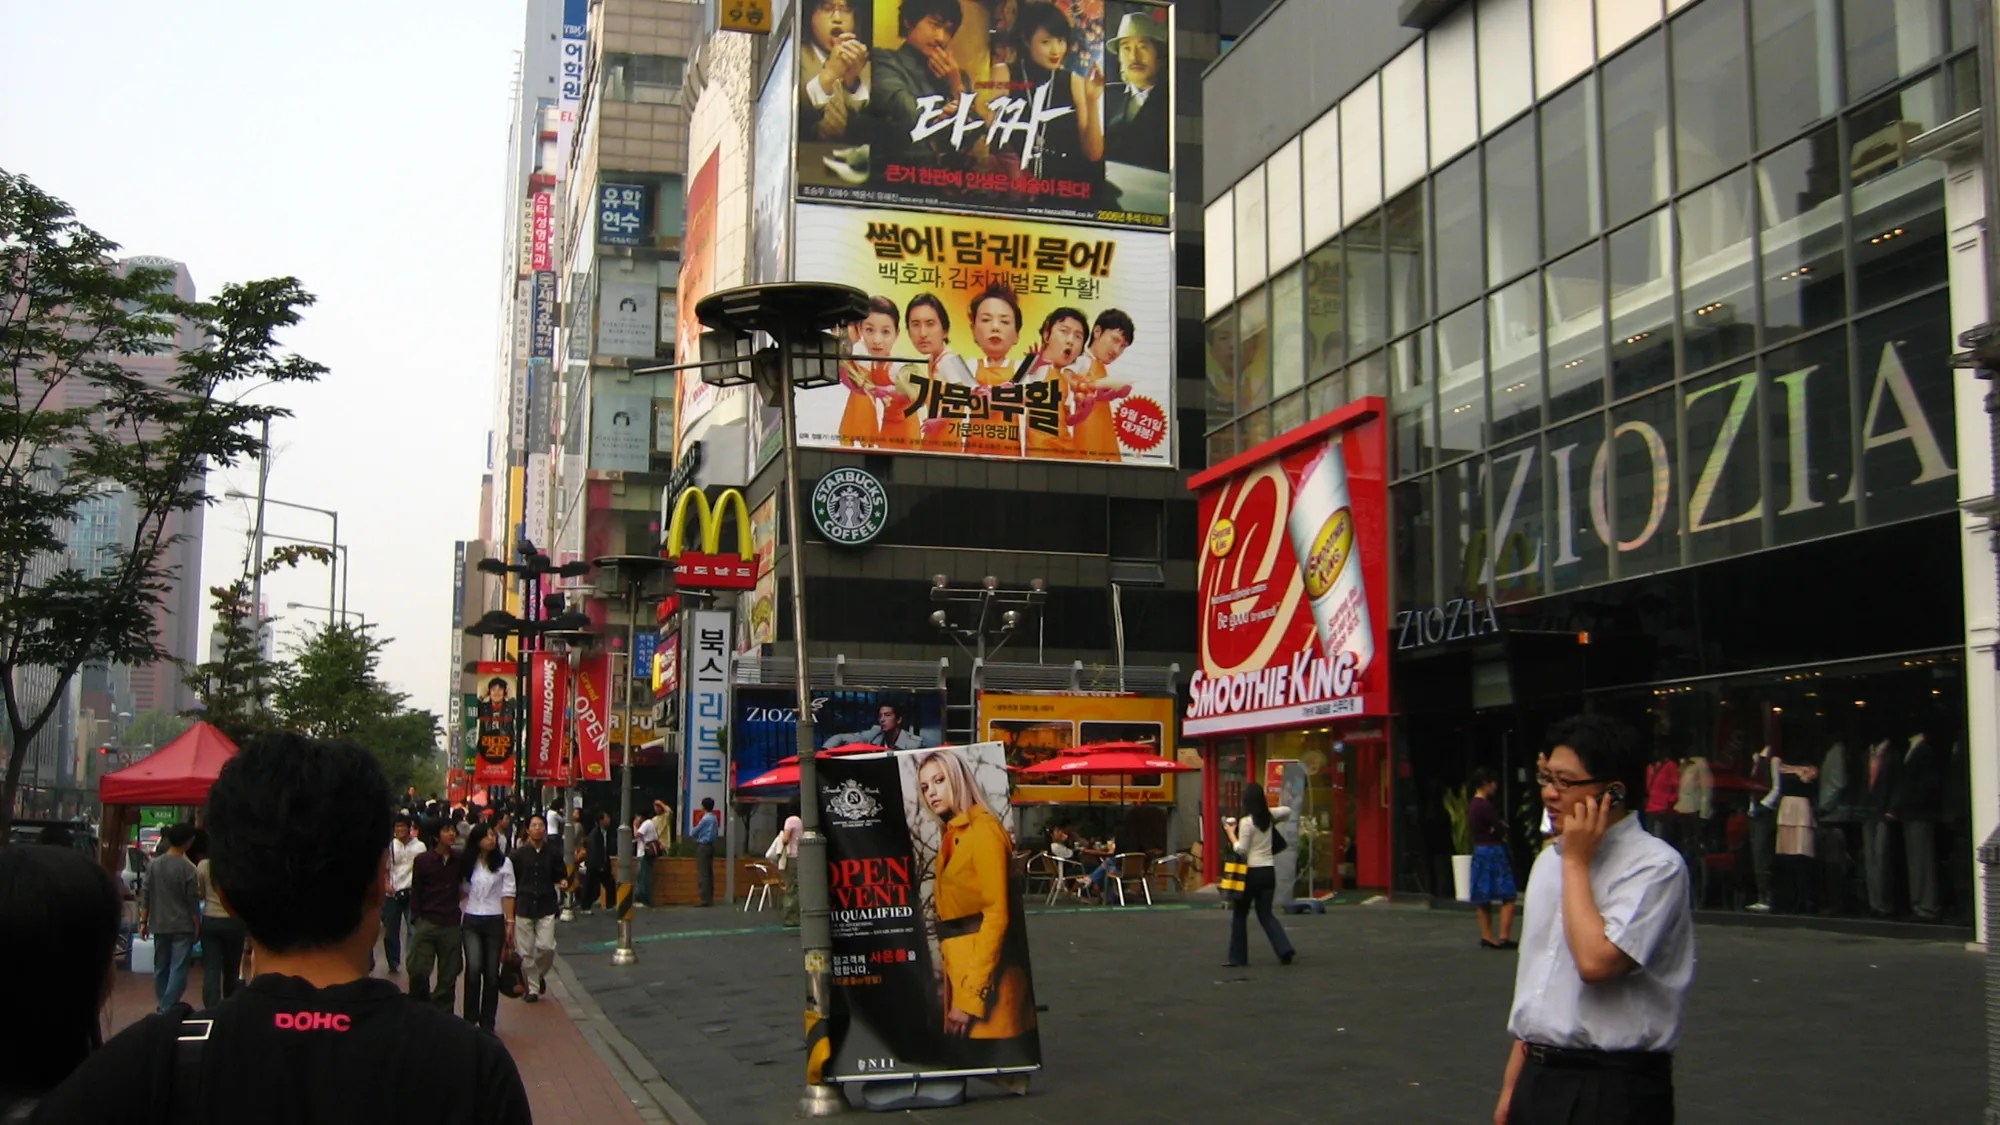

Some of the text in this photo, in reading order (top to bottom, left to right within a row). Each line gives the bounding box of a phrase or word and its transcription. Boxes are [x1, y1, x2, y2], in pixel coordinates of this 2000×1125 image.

[563, 43, 583, 100] 어학원
[909, 79, 1077, 171] 타짜
[885, 163, 916, 184] 큰거
[919, 168, 962, 188] 한판에
[966, 172, 1010, 193] 인생은
[602, 187, 641, 211] 유학
[602, 210, 640, 234] 연수
[866, 222, 945, 263] 썰어!
[1034, 236, 1116, 278] 묻어!
[878, 261, 1101, 300] 백호파, 김치재벌로 부활!
[904, 374, 1063, 437] 가문의 부활
[1120, 406, 1164, 430] 9월 21일
[1121, 420, 1154, 442] 대개봉!
[1478, 341, 1959, 588] ZIOZIA
[816, 471, 883, 506] STARBUCKS
[823, 520, 877, 540] COFFEE
[1397, 597, 1500, 650] ZIOZIA
[542, 659, 557, 726] SMOOTHIE
[580, 671, 599, 701] Grand
[1186, 665, 1289, 718] SMOOTHIE
[574, 696, 610, 752] OPEN
[746, 707, 819, 723] ZIOZ
[540, 725, 553, 762] KING
[833, 884, 912, 911] VENT
[840, 907, 913, 923] QUALIFIED
[275, 1011, 352, 1032] DOHC
[868, 1058, 894, 1068] NII
